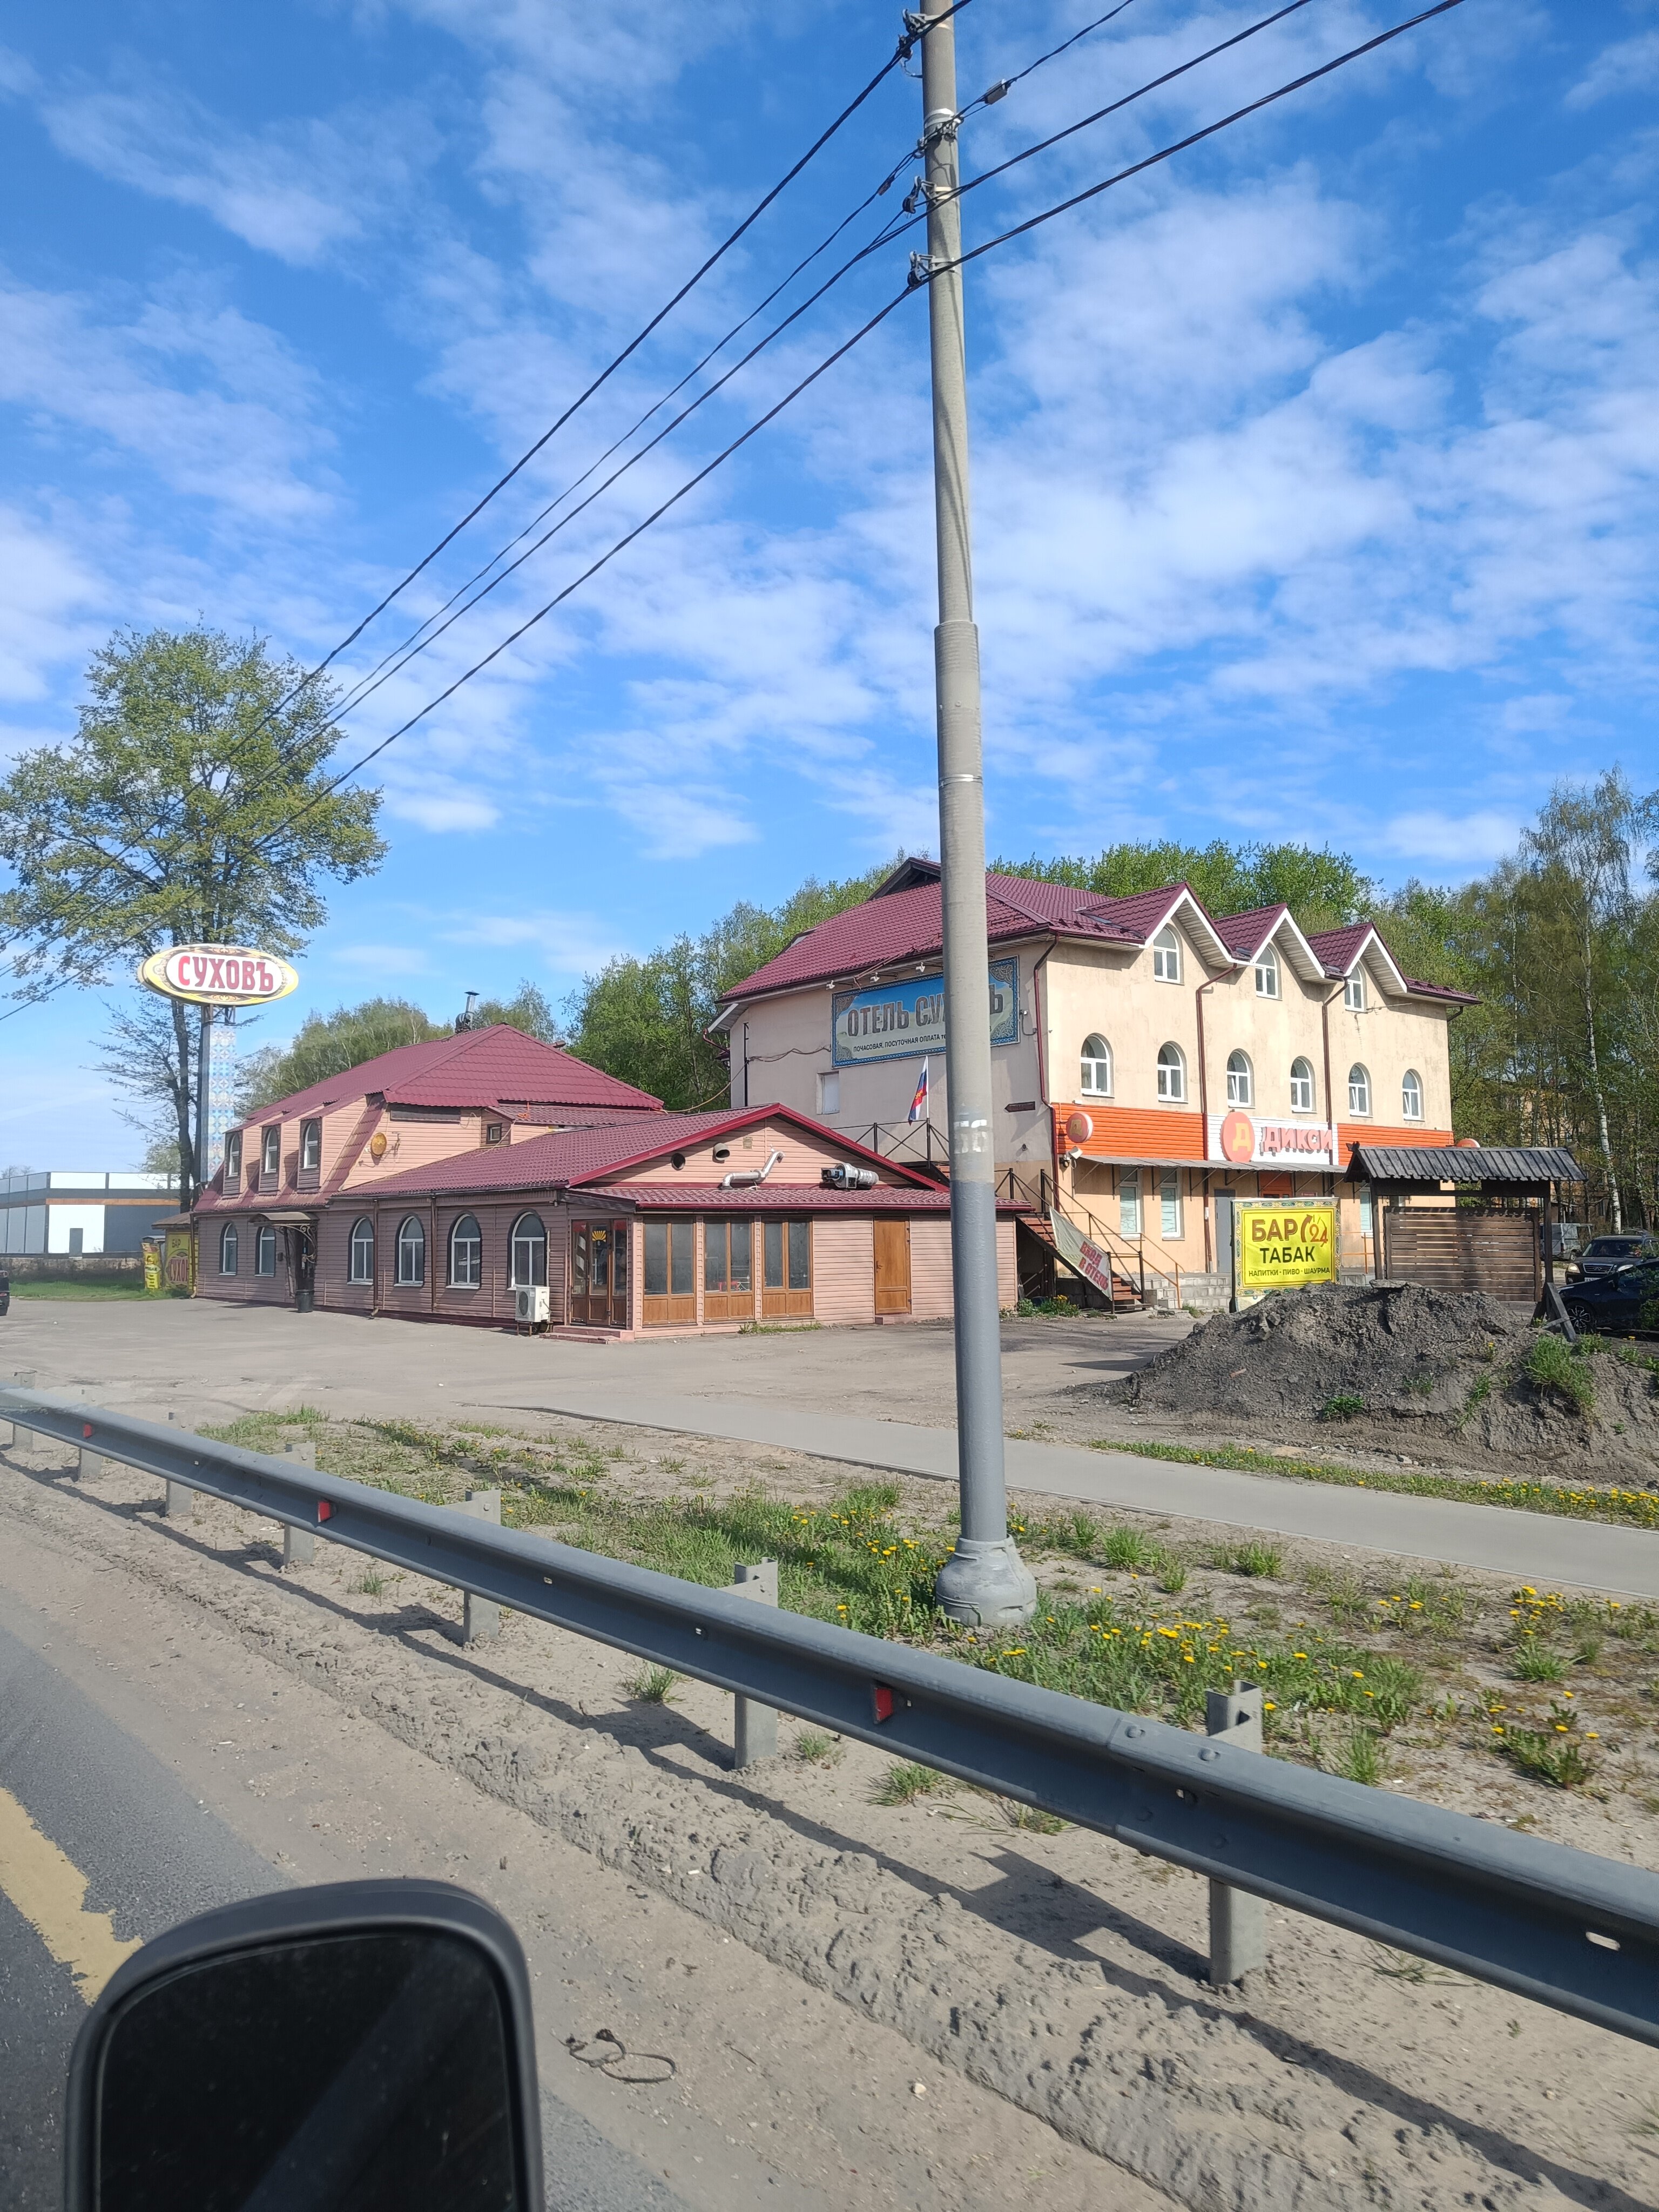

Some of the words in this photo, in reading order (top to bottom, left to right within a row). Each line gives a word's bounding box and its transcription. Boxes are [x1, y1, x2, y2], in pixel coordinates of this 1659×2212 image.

[178, 956, 273, 992] СУХОВЪ
[847, 1001, 909, 1036] ОТЕЛЬ
[885, 1037, 918, 1048] ПОСУТОЧНАЯ
[919, 1034, 940, 1043] ОПЛАТА
[1264, 1127, 1333, 1152] ДИКСИ
[1252, 1218, 1298, 1242] БАР
[1309, 1224, 1328, 1243] 24
[1259, 1246, 1316, 1264] ТАБАК
[1249, 1269, 1279, 1277] НАПИТКИ
